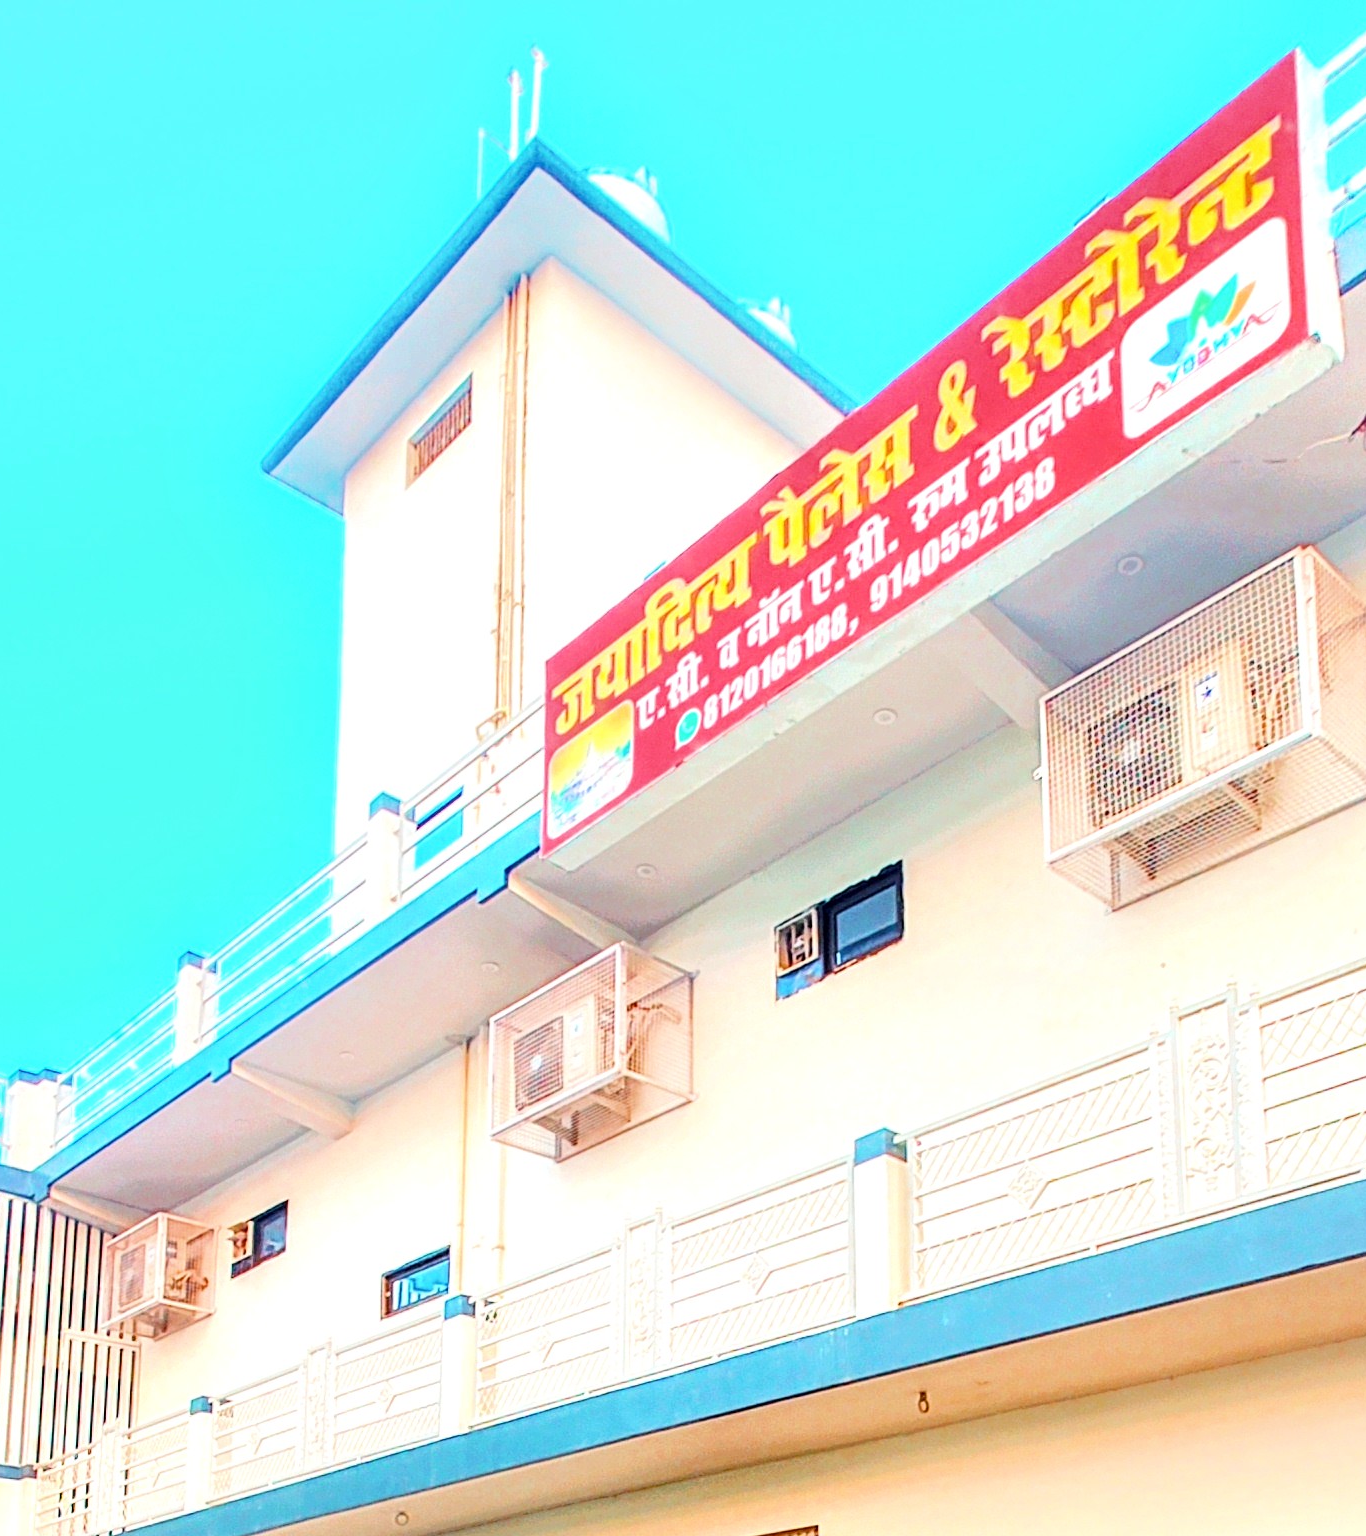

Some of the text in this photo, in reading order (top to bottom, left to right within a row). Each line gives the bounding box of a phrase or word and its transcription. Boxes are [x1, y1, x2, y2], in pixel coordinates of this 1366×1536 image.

[552, 113, 1281, 735] जयादित्य पैलेस & रेस्टोरेन्ट
[703, 456, 1056, 730] 8120166188, 9140532138
[717, 626, 742, 670] व
